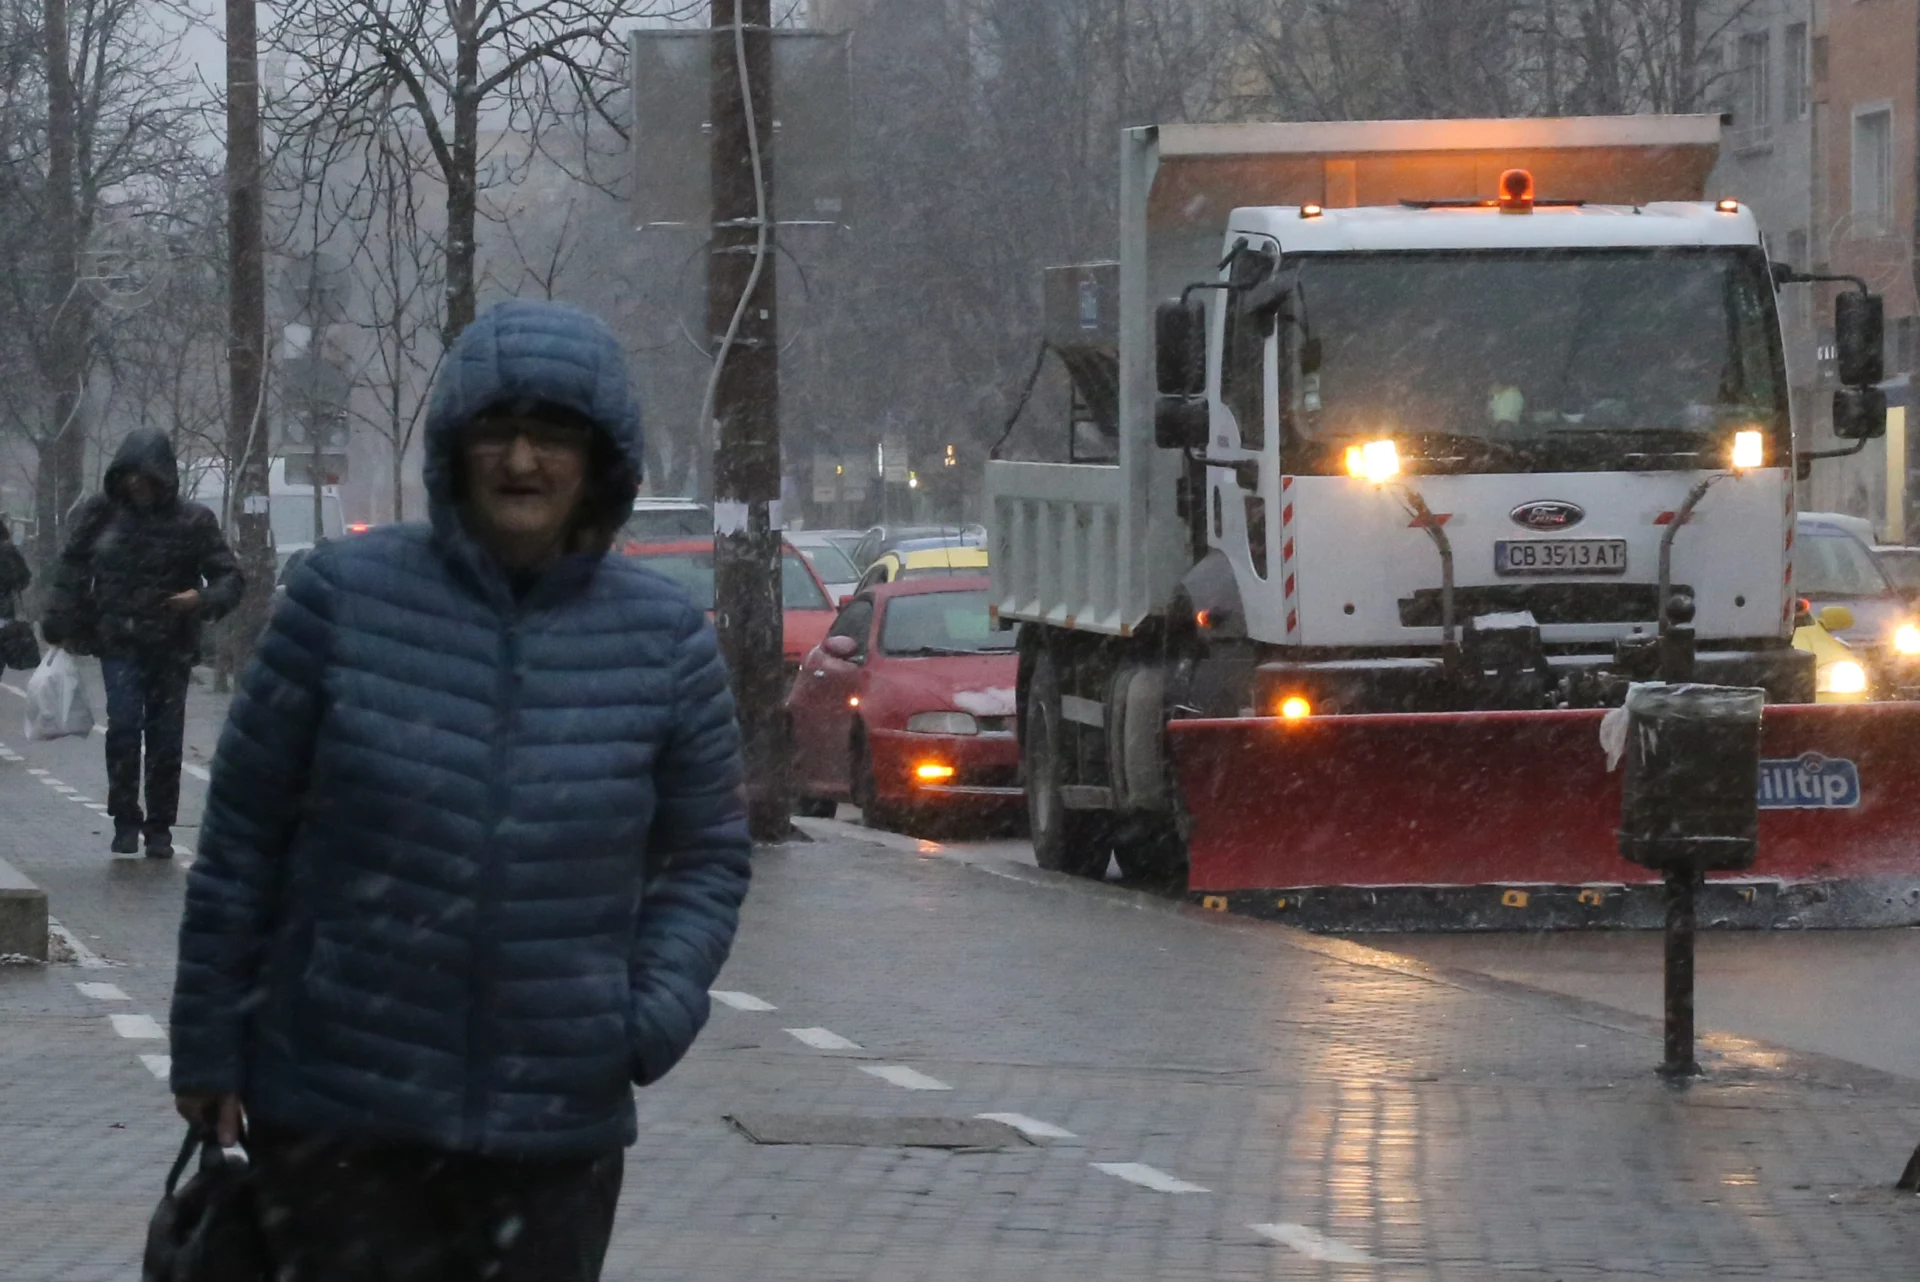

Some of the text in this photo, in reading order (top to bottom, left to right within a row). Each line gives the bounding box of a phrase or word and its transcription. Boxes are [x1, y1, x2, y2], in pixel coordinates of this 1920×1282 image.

[1510, 545, 1620, 566] CB 3513 AT
[1757, 768, 1849, 806] illtip
